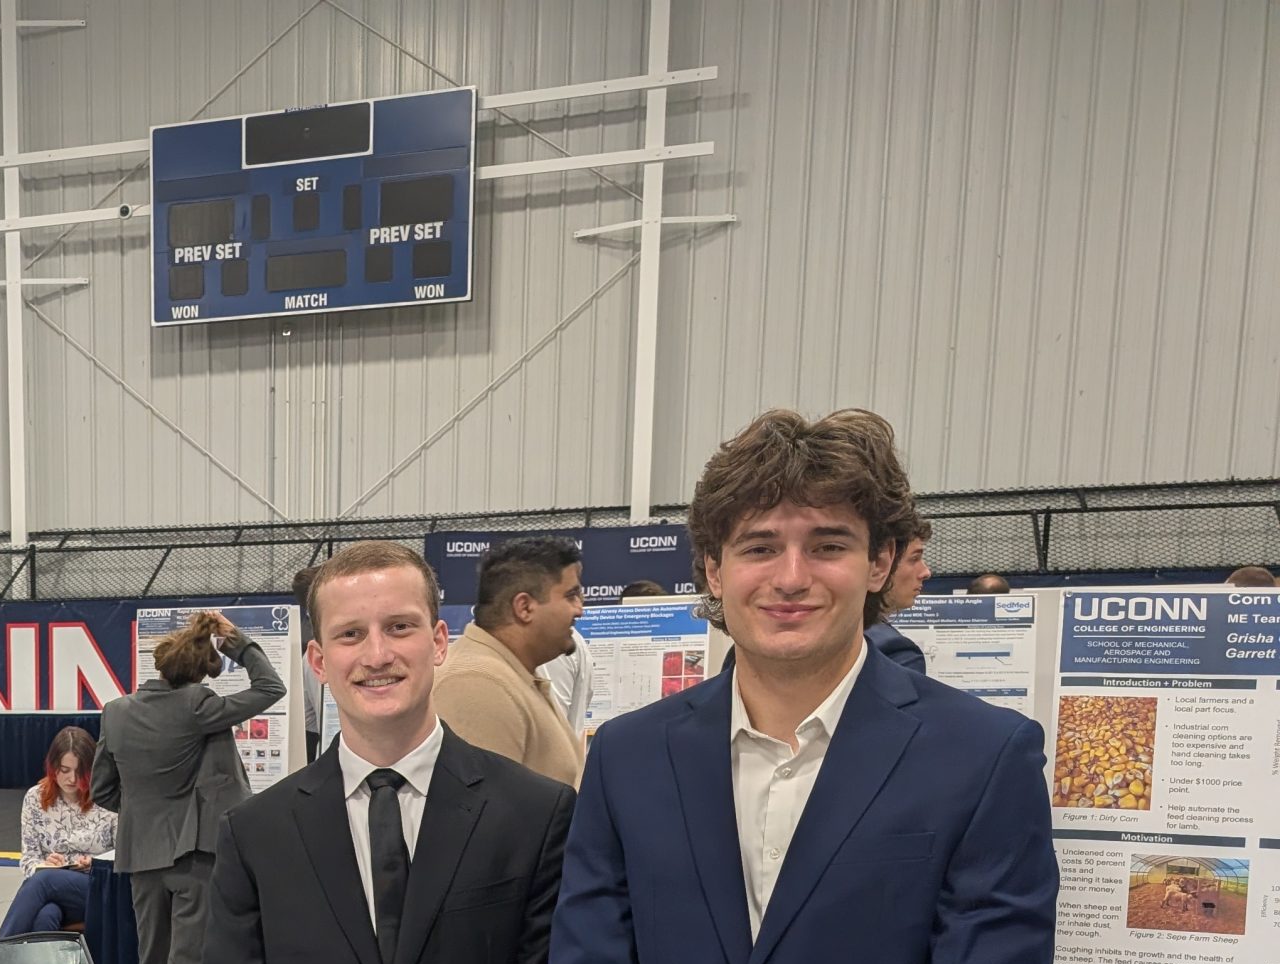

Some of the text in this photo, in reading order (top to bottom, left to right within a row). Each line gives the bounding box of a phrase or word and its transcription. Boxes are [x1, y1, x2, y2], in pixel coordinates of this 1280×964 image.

[296, 177, 319, 191] SET
[370, 222, 443, 244] PREV SET
[175, 243, 242, 263] PREV SET
[415, 284, 444, 299] WON
[285, 293, 328, 309] MATCH
[172, 305, 199, 319] WON
[630, 536, 677, 548] UCONN
[1228, 594, 1271, 605] Corn
[1074, 597, 1207, 620] UCONN
[1227, 614, 1248, 624] ME
[1137, 625, 1206, 633] ENGINEERING
[1227, 634, 1274, 643] Grisha
[1226, 648, 1275, 659] Garrett
[1145, 657, 1200, 665] ENGINEERING
[1103, 679, 1162, 687] Introduction
[1172, 680, 1212, 688] Problem
[1195, 706, 1211, 714] part
[1213, 706, 1236, 714] focus.
[1172, 732, 1205, 741] cleaning
[1208, 733, 1236, 741] options
[1186, 743, 1227, 751] expensive
[1192, 751, 1226, 760] cleaning
[1186, 760, 1204, 768] long.
[1170, 777, 1242, 788] Under $1000 price
[1169, 786, 1189, 794] point.
[1167, 804, 1185, 813] Help
[1187, 805, 1224, 813] automate
[1063, 813, 1088, 822] Figure
[1099, 814, 1117, 823] Dirty
[1167, 813, 1184, 821] feed
[1186, 814, 1219, 823] cleaning
[1179, 822, 1200, 830] lamb.
[1121, 833, 1173, 843] Motivation
[1129, 931, 1154, 940] Figure
[1166, 933, 1186, 941] Sepe
[1189, 934, 1210, 942] Farm
[1212, 935, 1239, 945] Sheep
